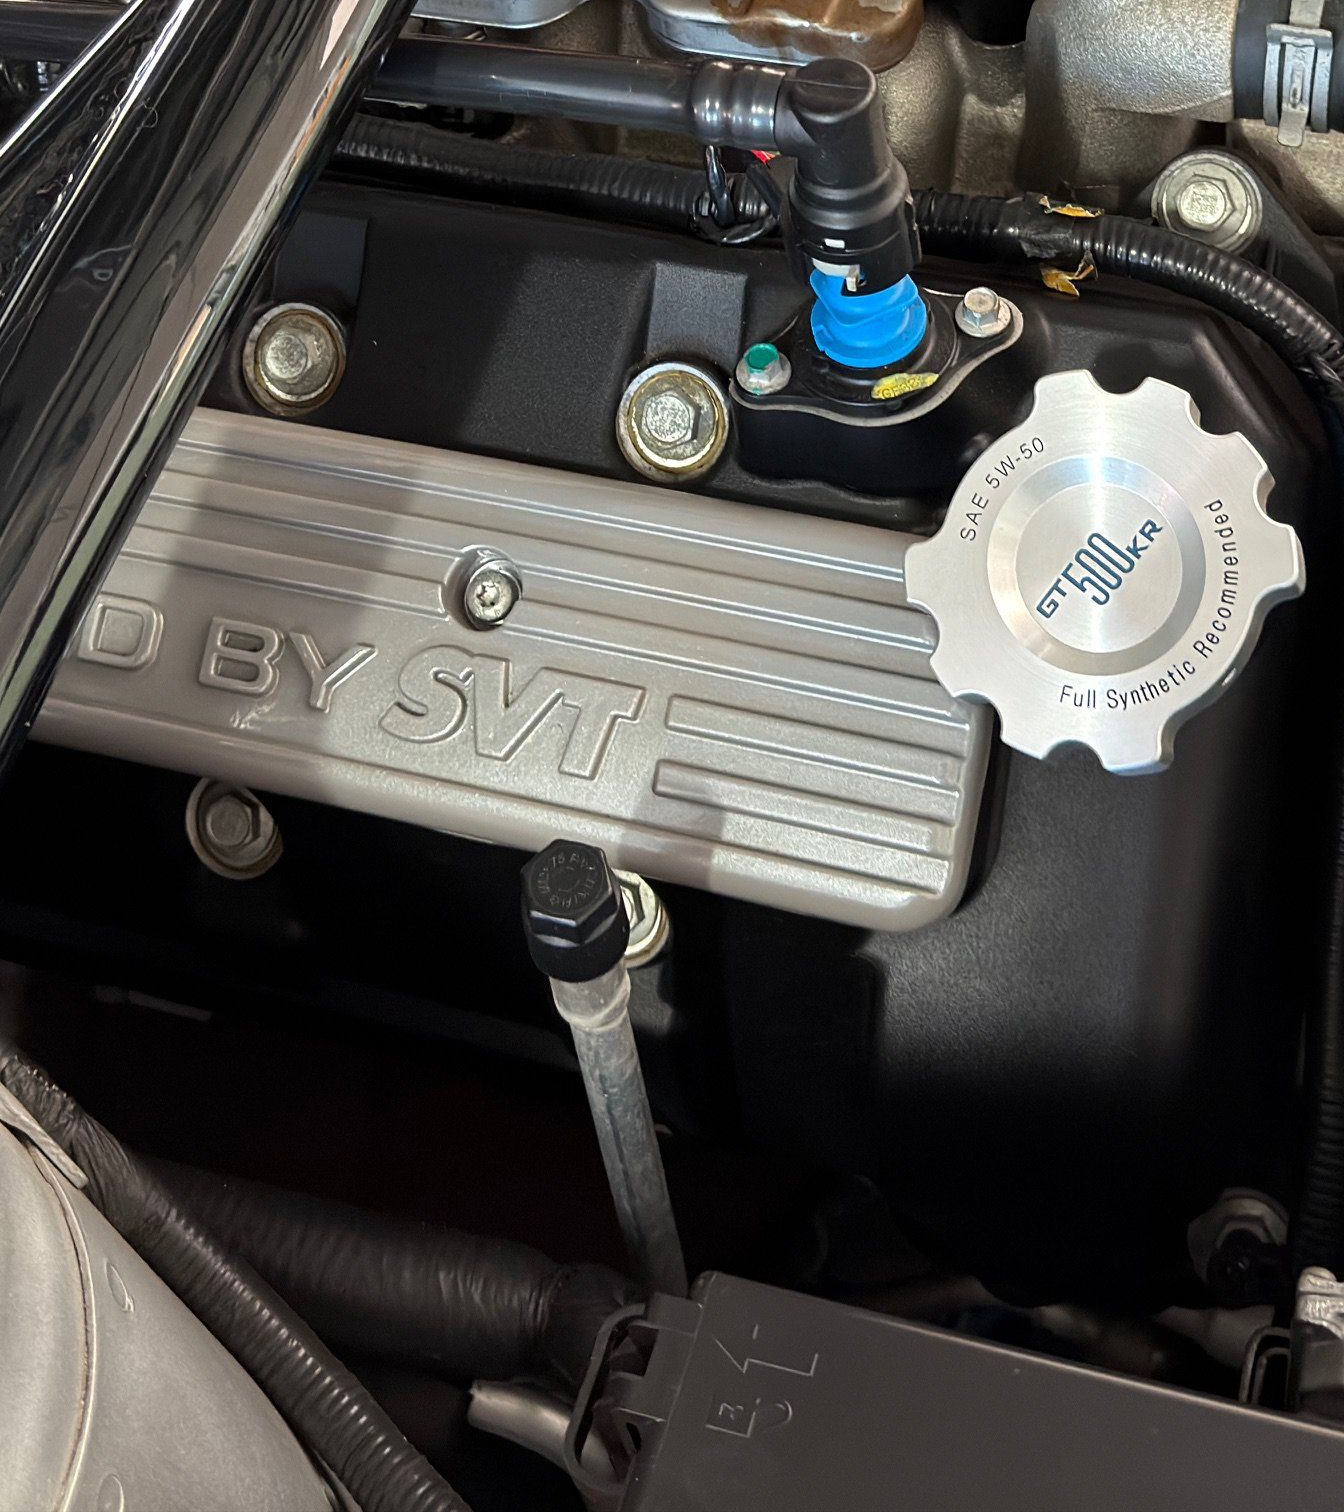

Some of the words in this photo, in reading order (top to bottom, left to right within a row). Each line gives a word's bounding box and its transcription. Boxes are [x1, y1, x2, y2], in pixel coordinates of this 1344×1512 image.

[959, 491, 990, 541] SAE
[984, 436, 1046, 492] 5W-50
[1035, 517, 1164, 621] GT500KR
[1059, 683, 1098, 710] Full
[1106, 658, 1196, 712] Synthetic
[1193, 497, 1240, 660] Recommended
[198, 616, 379, 712] BY
[378, 645, 648, 781] SVT
